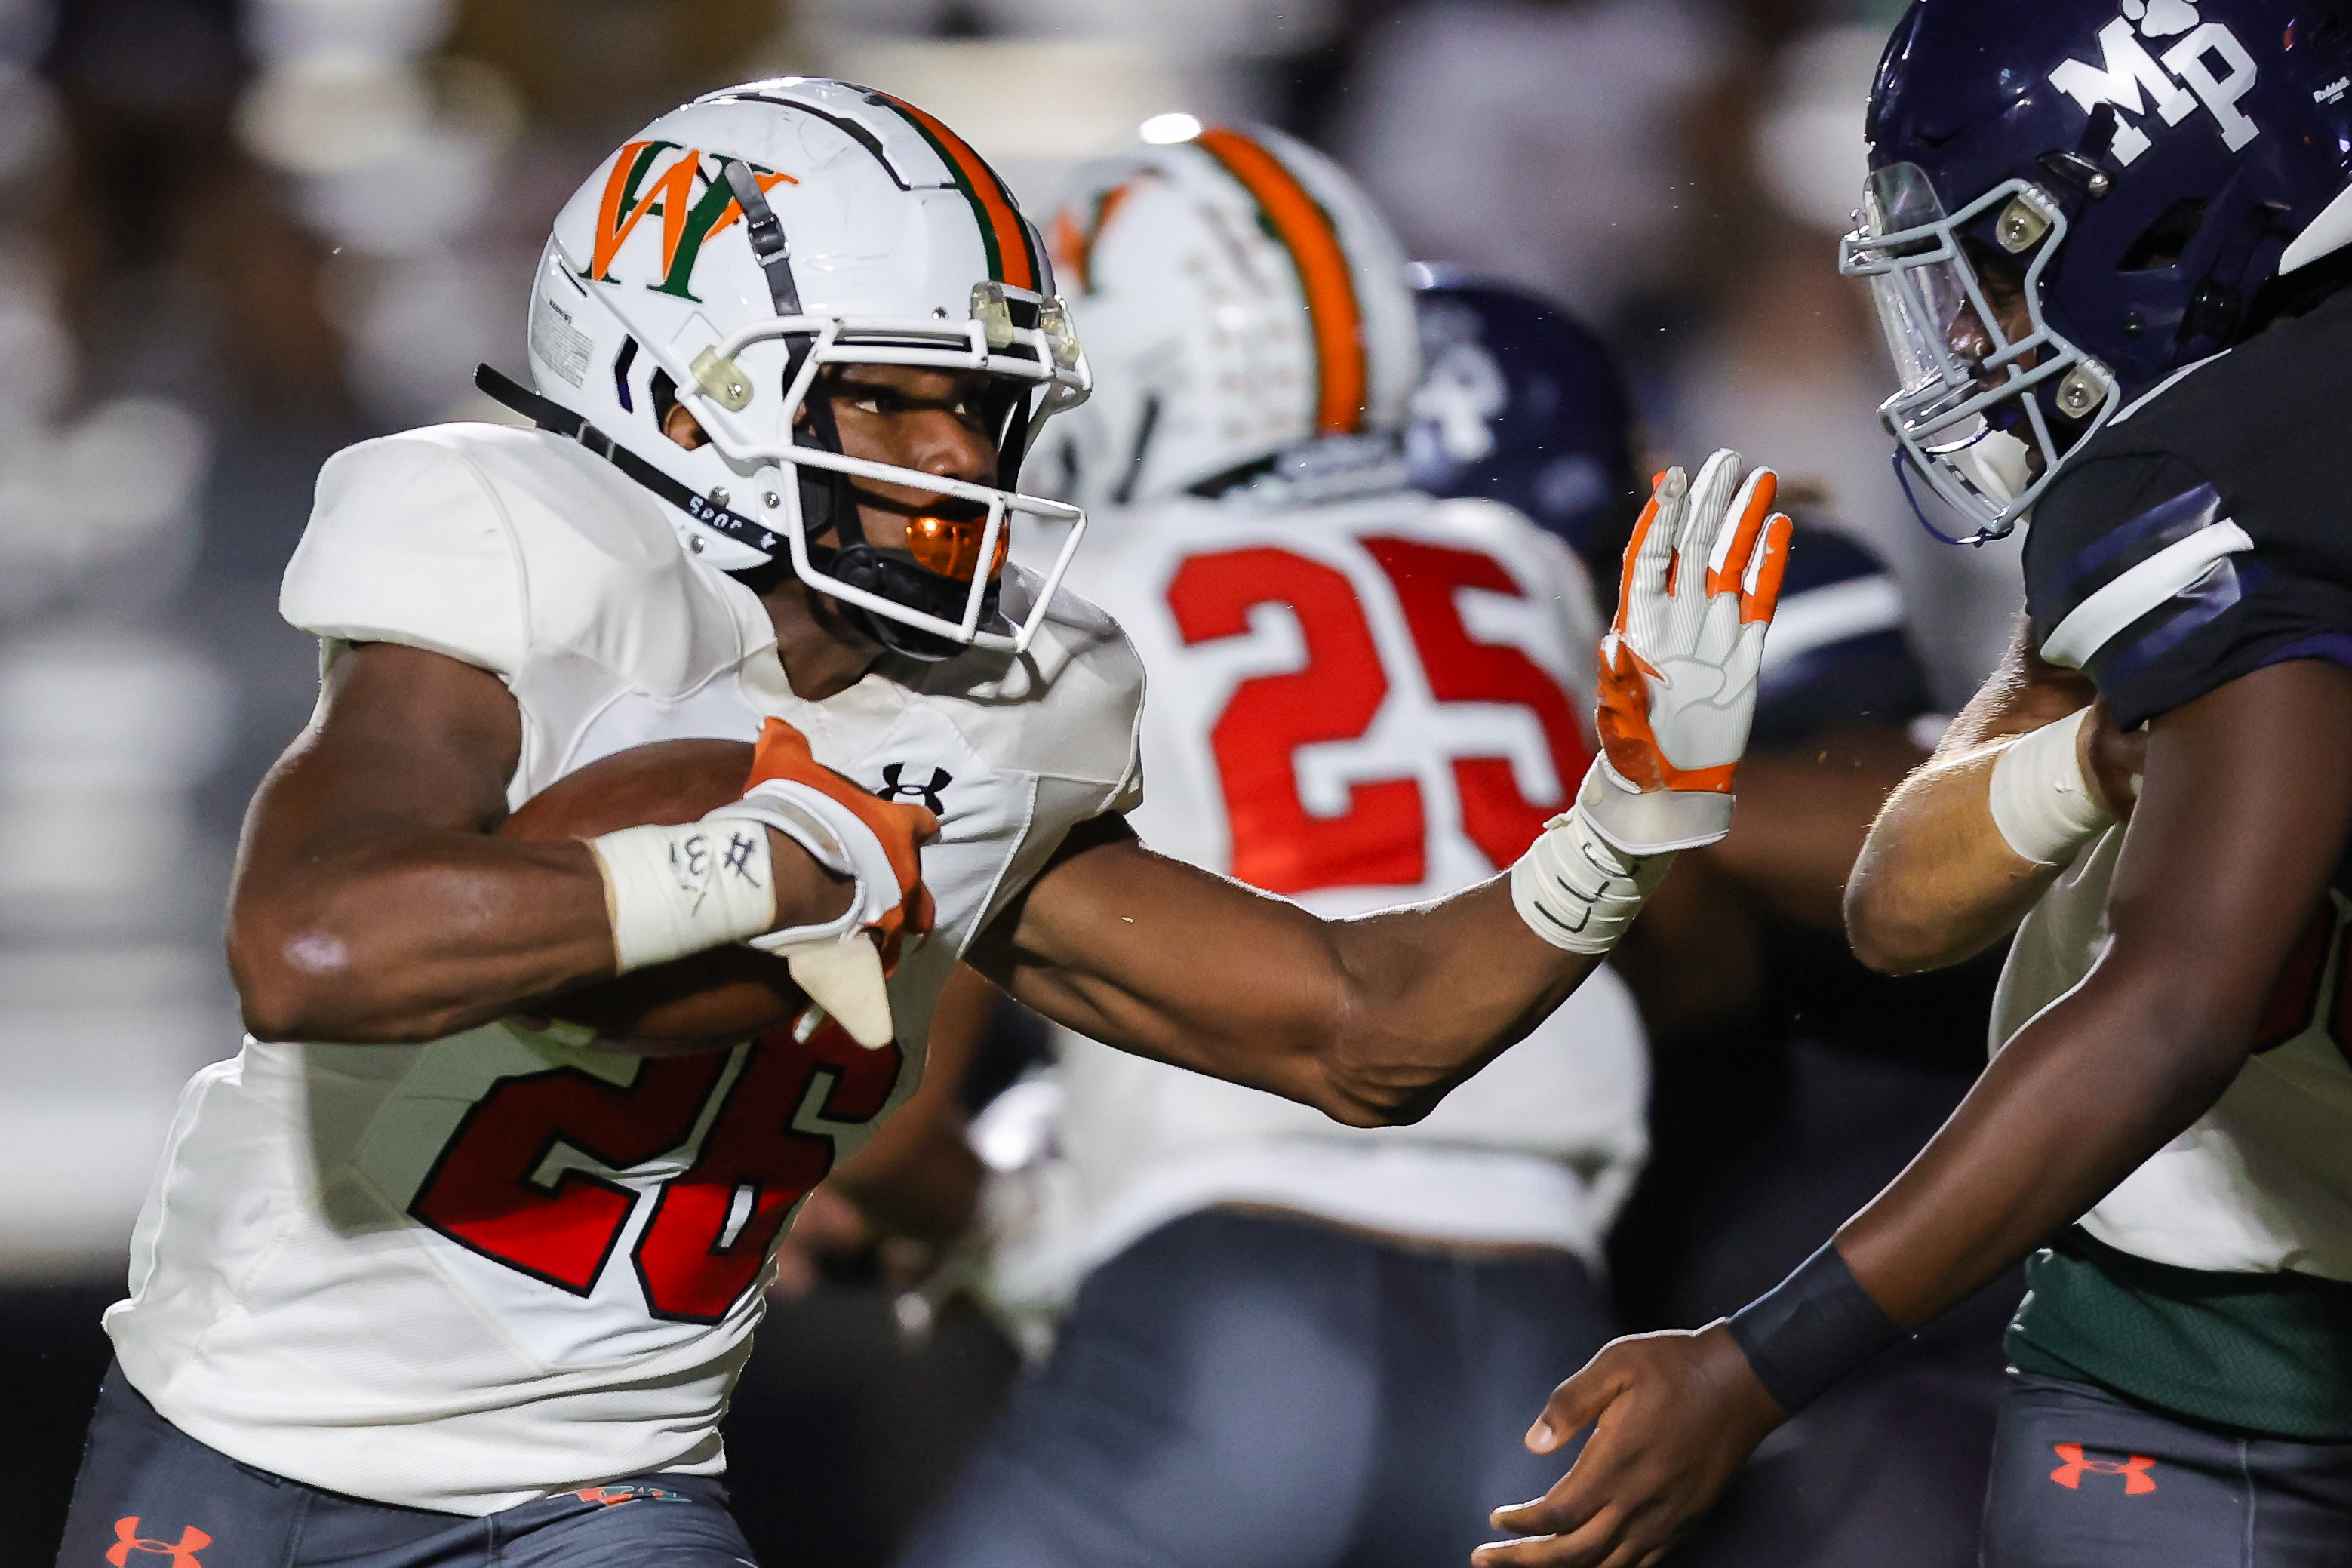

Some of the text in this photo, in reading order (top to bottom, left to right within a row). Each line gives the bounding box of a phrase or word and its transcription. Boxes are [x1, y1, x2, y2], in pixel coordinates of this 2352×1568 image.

[2046, 14, 2261, 168] MP
[1165, 533, 1601, 896] 25
[405, 1007, 903, 1327] 26
